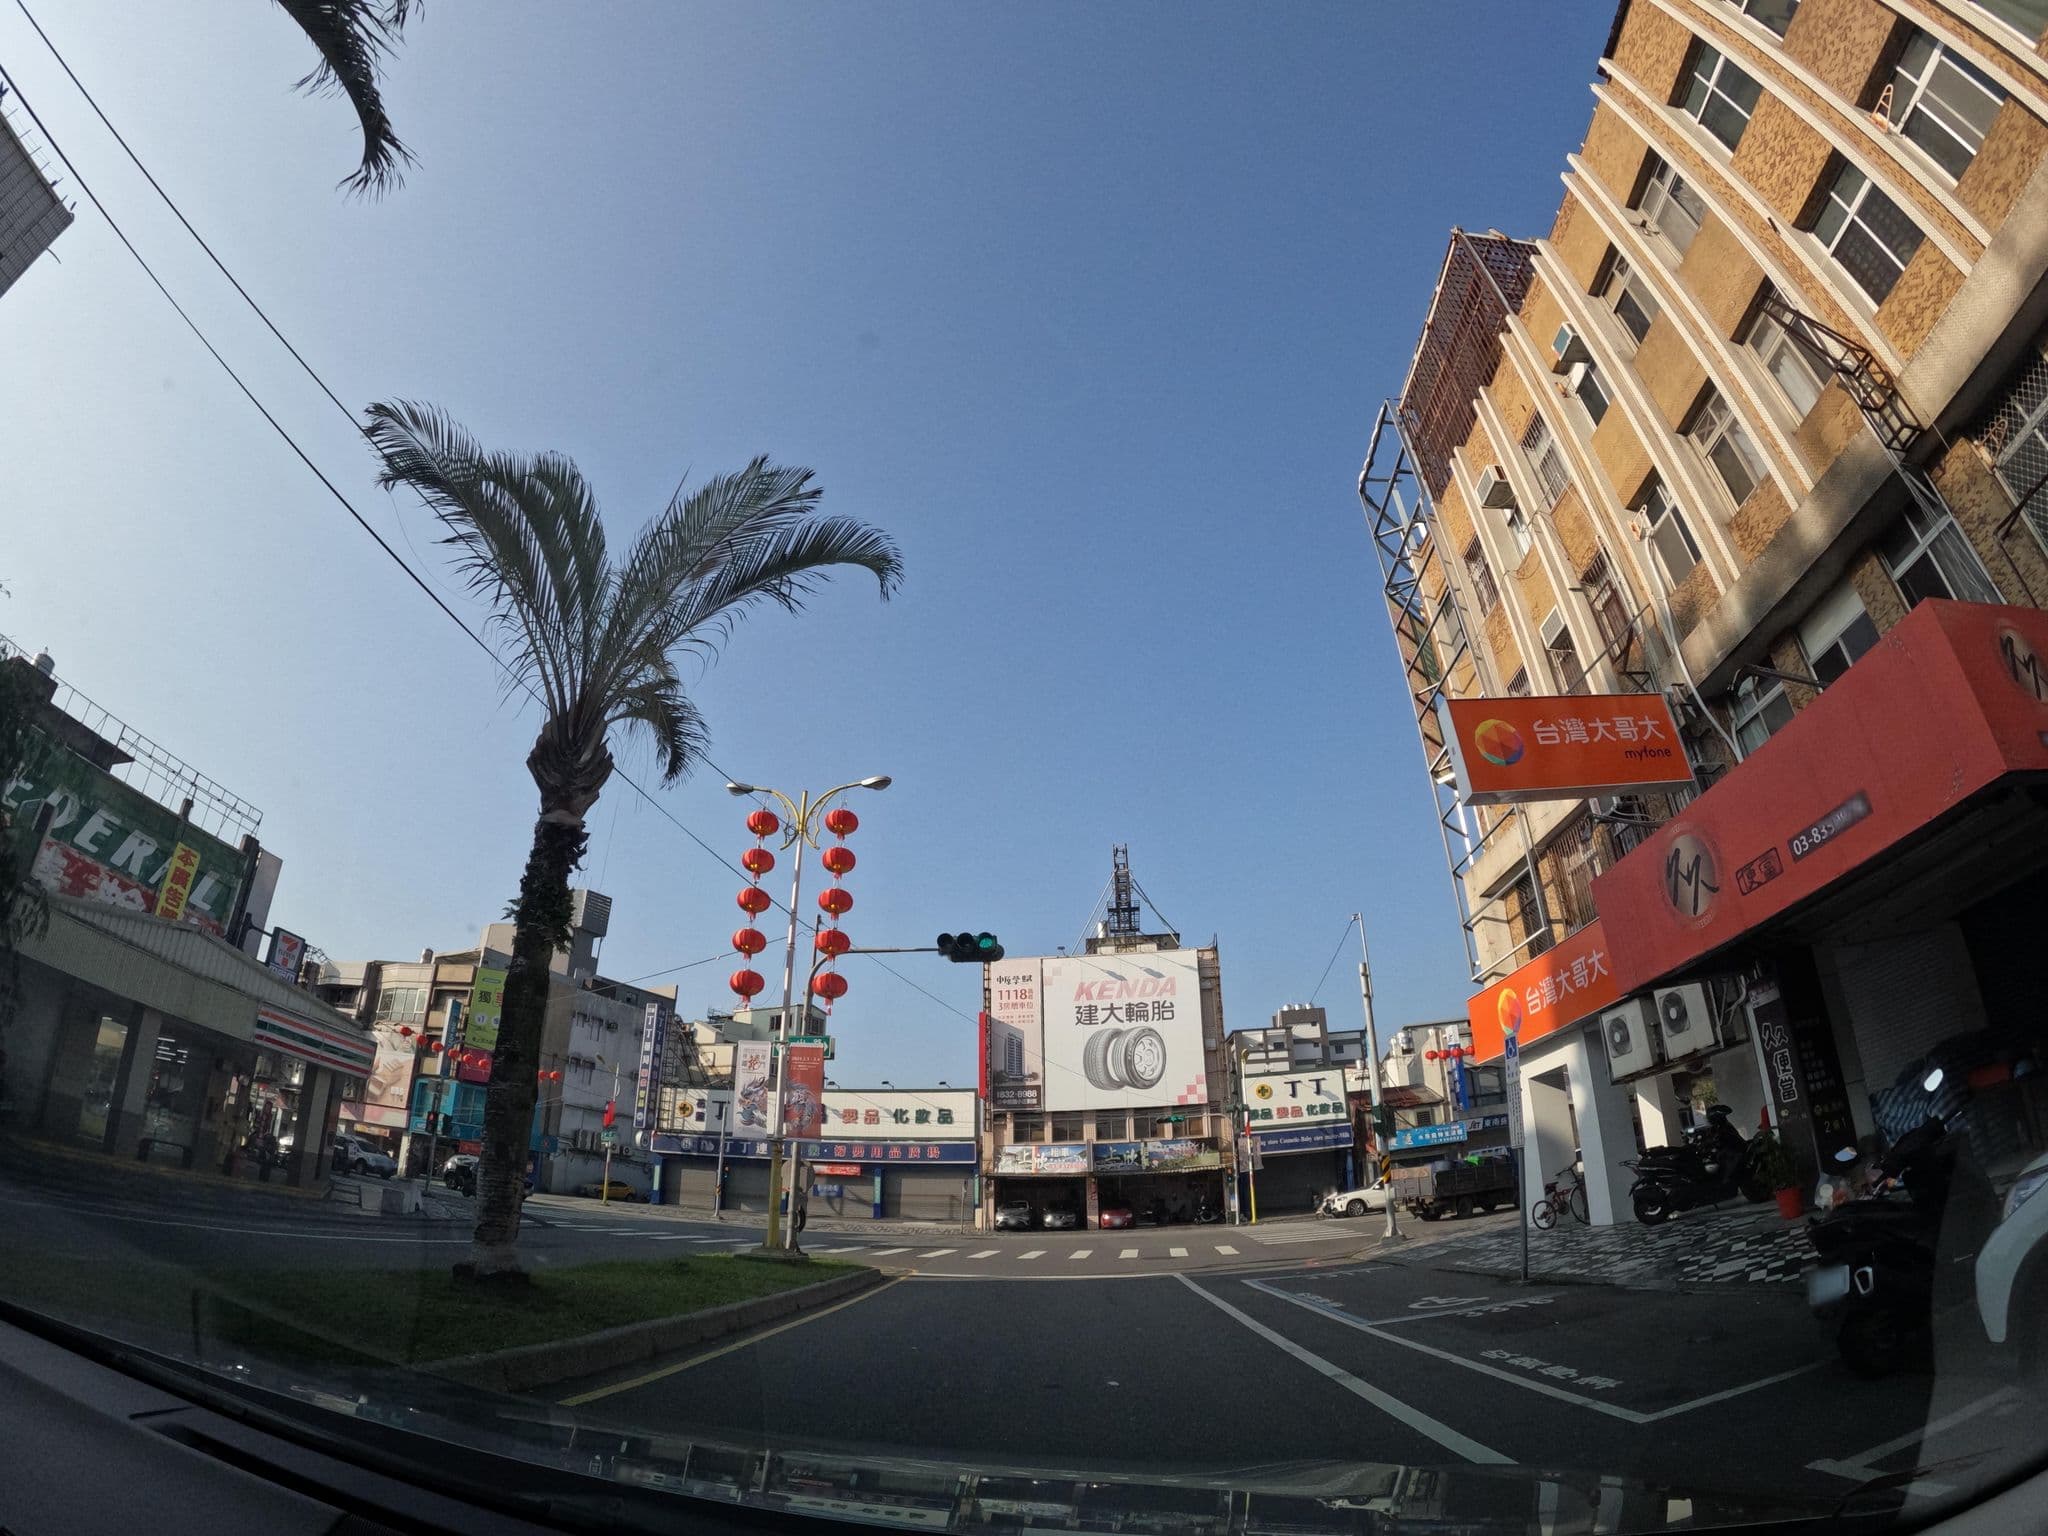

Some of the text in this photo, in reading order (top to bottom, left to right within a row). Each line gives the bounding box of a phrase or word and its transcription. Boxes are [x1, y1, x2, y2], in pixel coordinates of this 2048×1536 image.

[1532, 715, 1666, 745] 台灣大哥大
[1624, 746, 1672, 763] myfone
[998, 988, 1027, 1000] 1118
[1074, 976, 1177, 1002] KENDA
[1526, 949, 1609, 1016] 台灣大哥大
[1075, 1001, 1175, 1026] 建大輪胎
